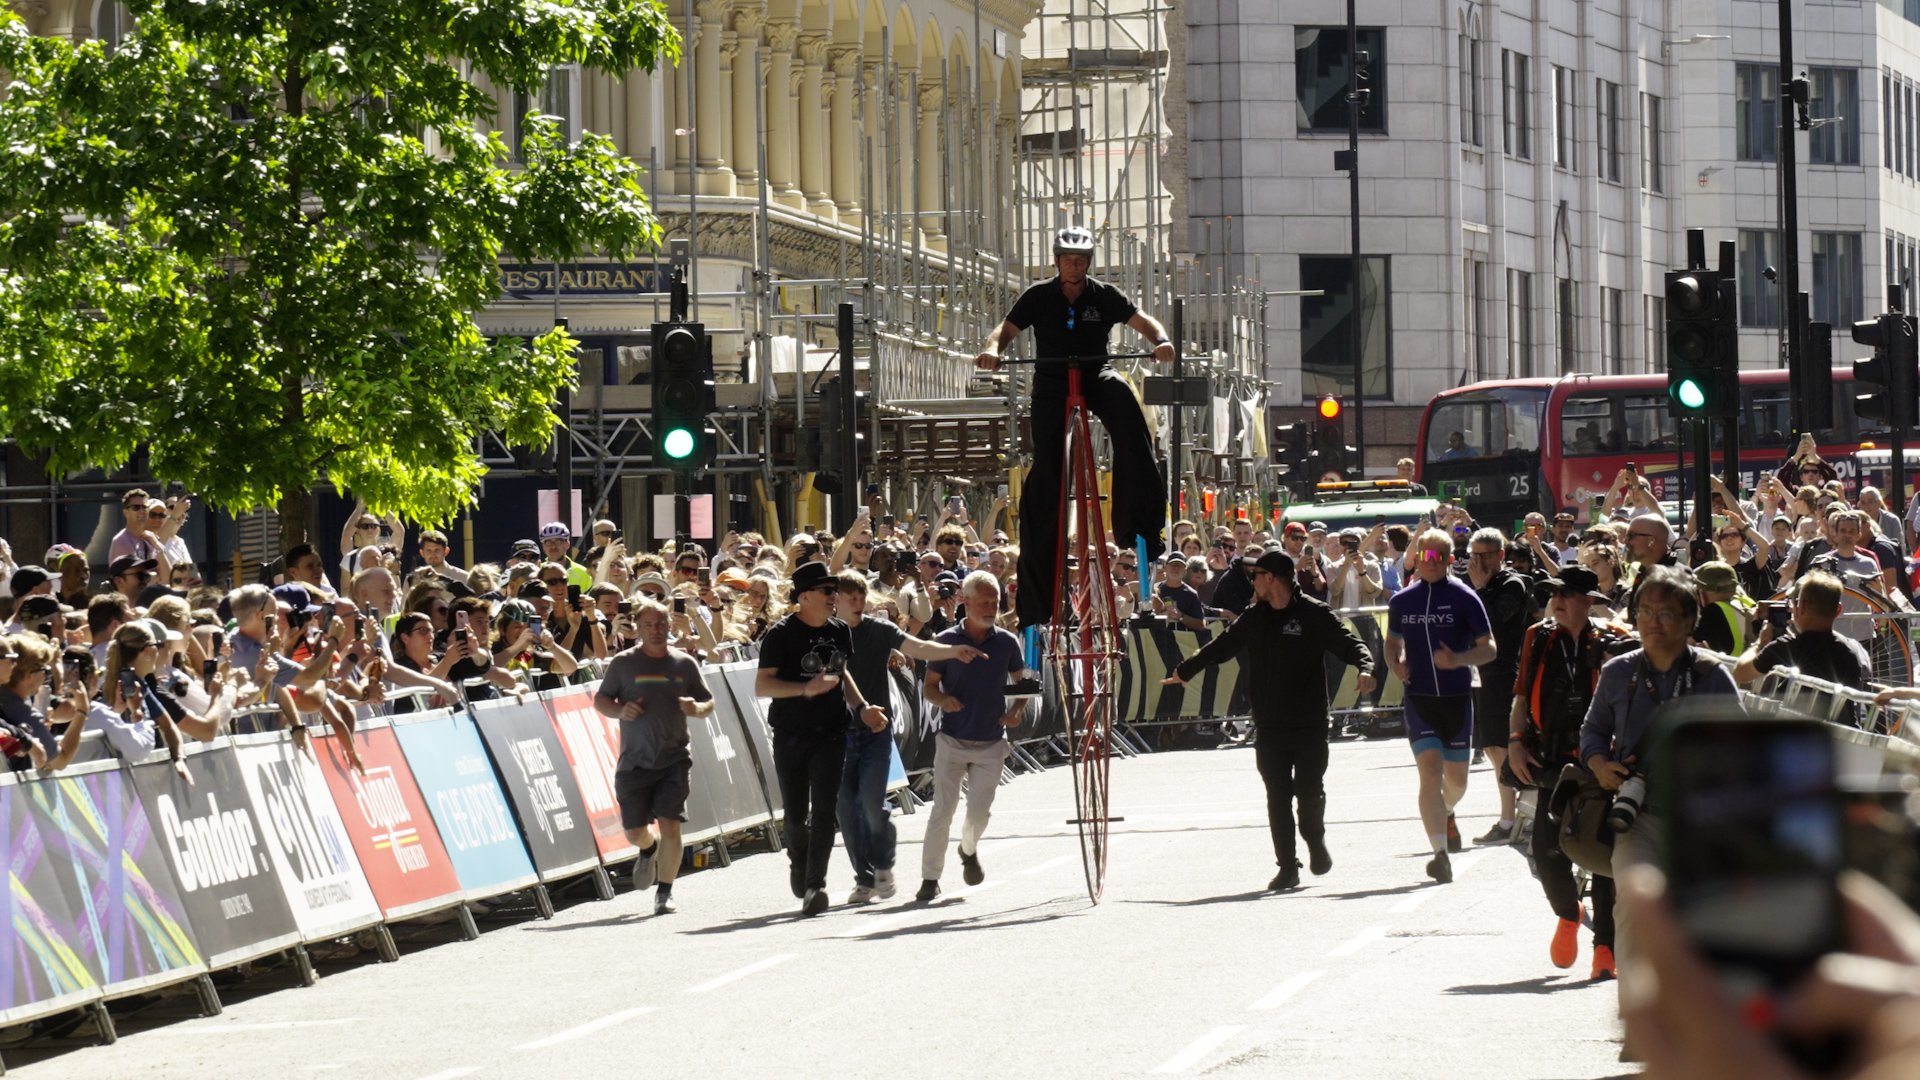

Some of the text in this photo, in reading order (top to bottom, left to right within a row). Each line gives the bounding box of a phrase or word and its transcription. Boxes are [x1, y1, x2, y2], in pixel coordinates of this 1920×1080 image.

[1455, 483, 1481, 496] ford
[1509, 475, 1530, 496] 25
[1401, 614, 1454, 624] BERRYS
[257, 757, 334, 883] CITY
[436, 781, 515, 851] CHEAPSIDE
